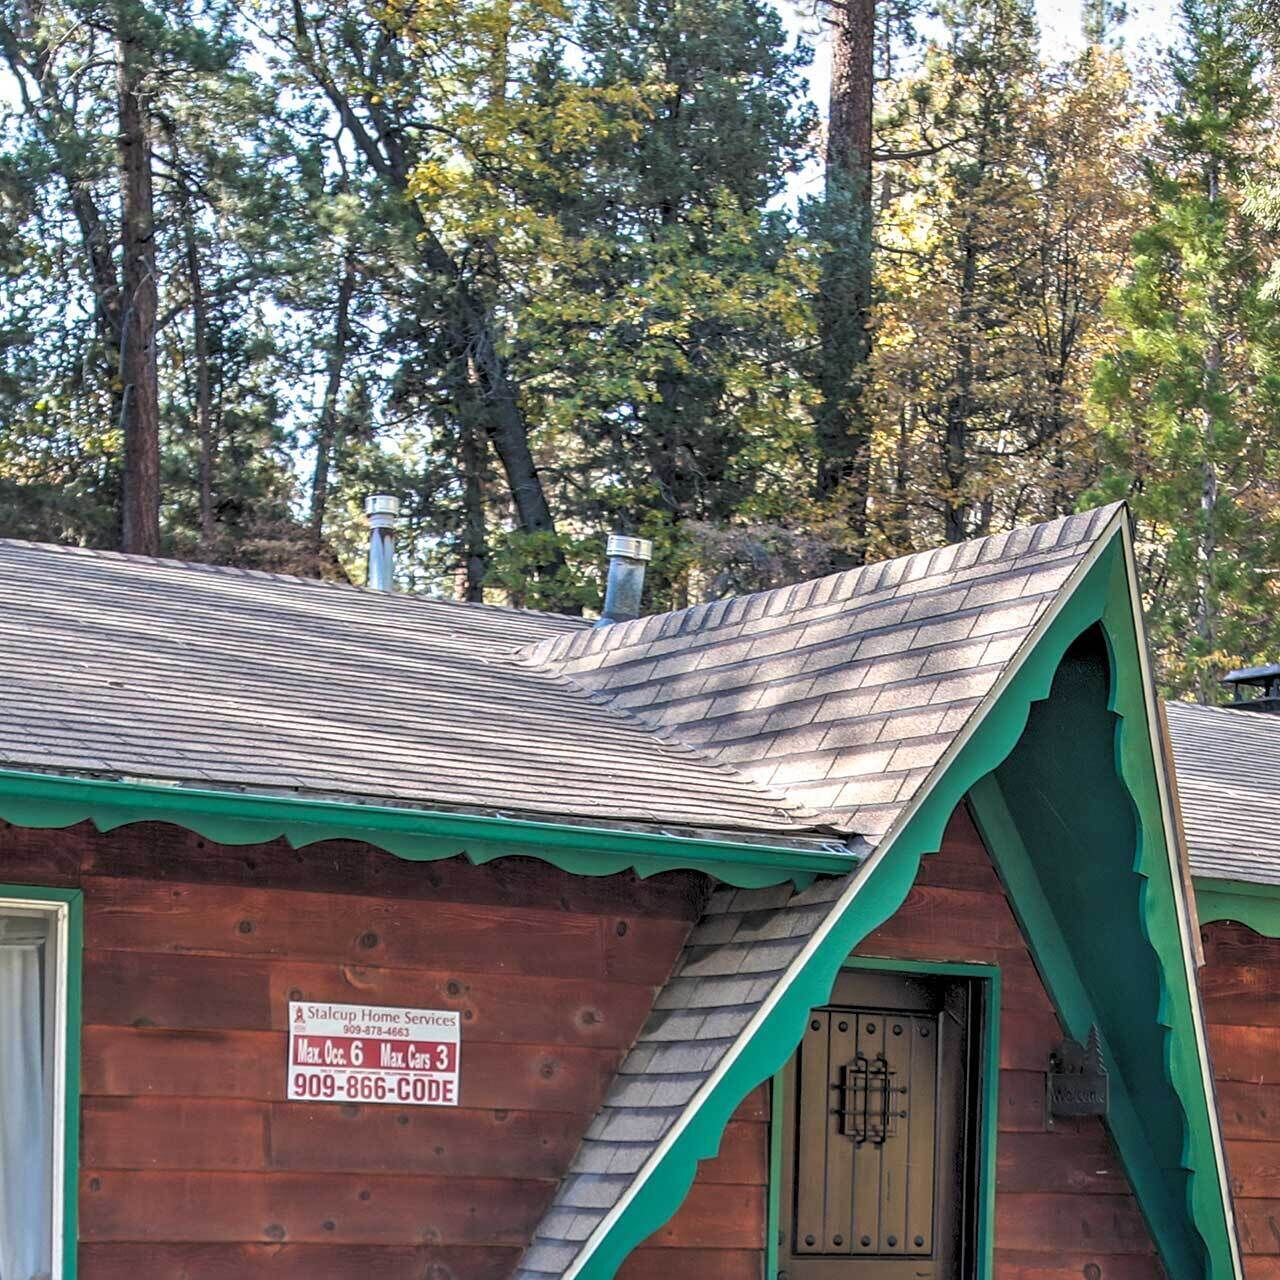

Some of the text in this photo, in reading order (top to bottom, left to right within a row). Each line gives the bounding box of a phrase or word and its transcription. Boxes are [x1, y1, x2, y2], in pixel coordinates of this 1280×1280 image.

[307, 1006, 456, 1027] Stalcup Home Services
[343, 1024, 410, 1038] 909-878-4663
[297, 1038, 363, 1066] Max. Occ. 6
[380, 1042, 448, 1071] Max. Cars 3
[293, 1072, 454, 1103] 909-866-CODE
